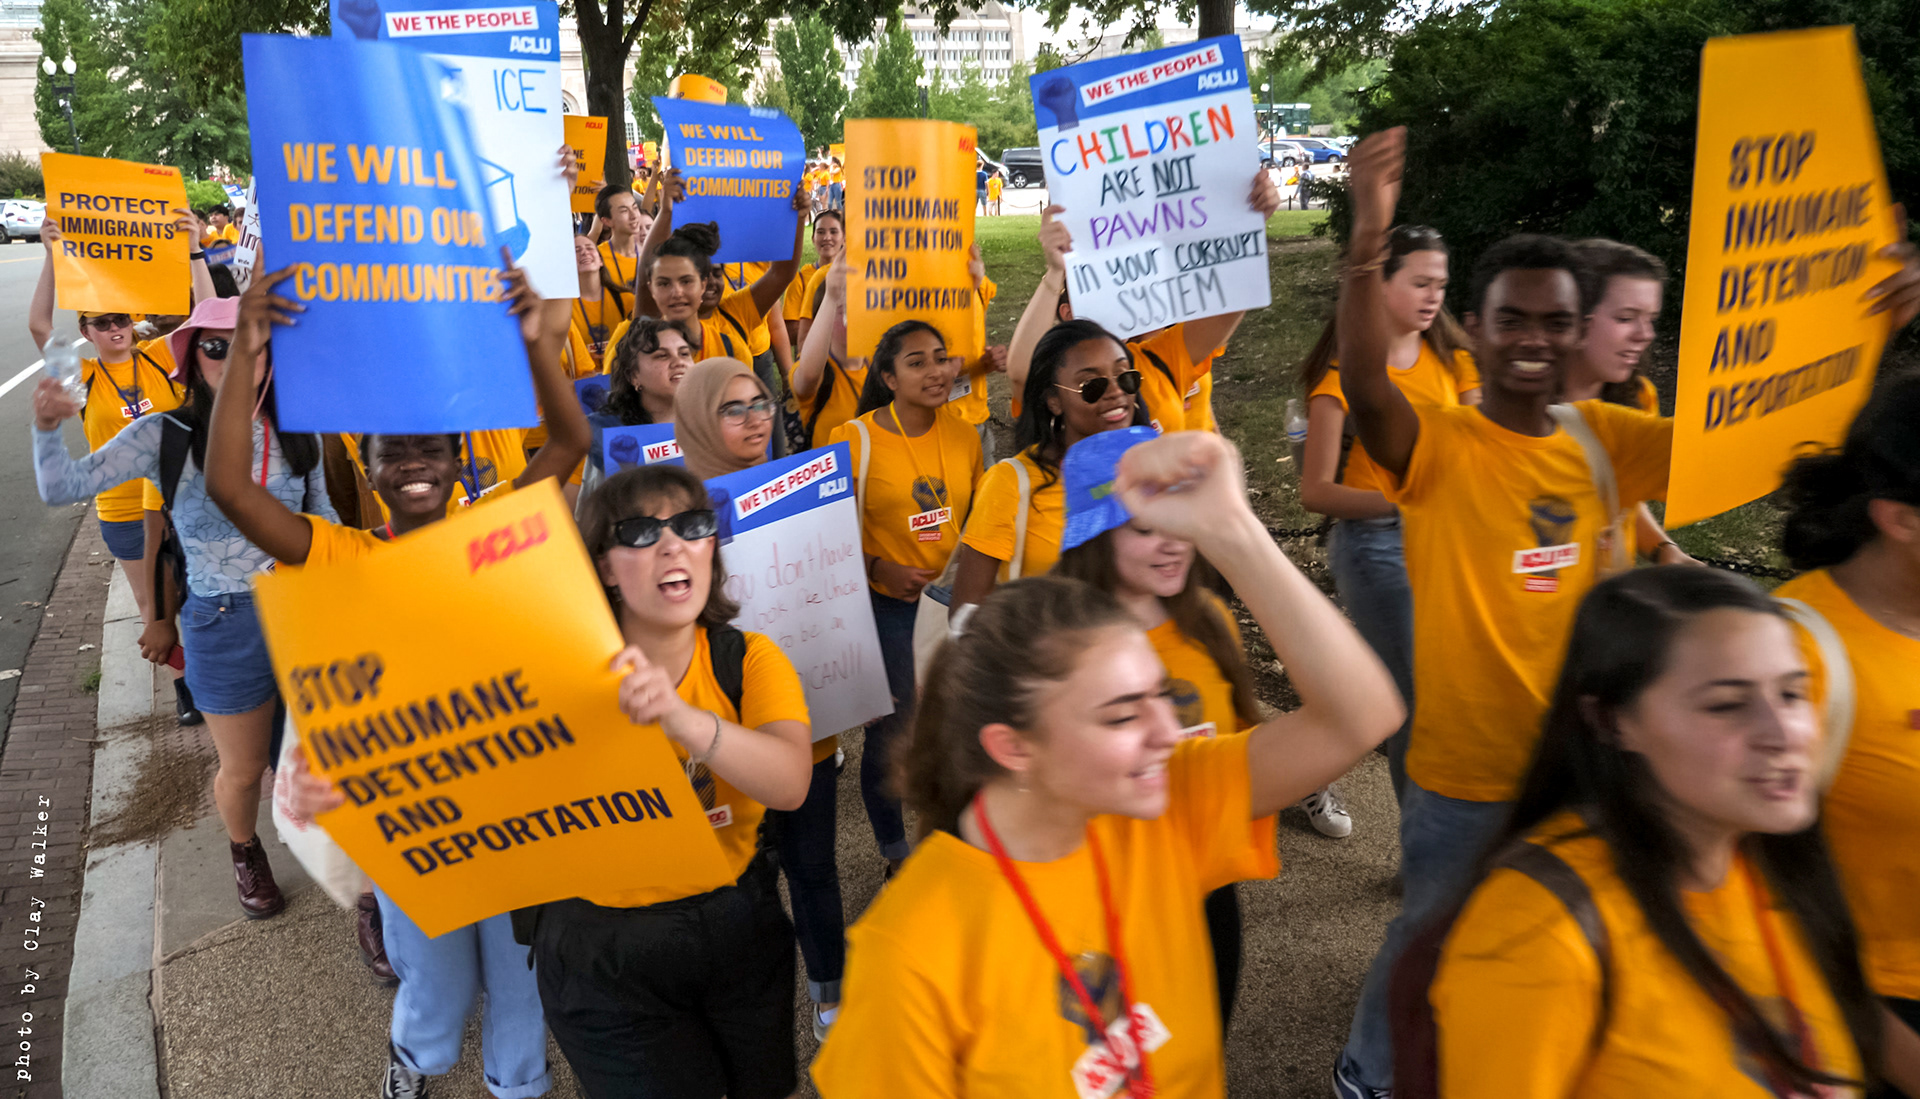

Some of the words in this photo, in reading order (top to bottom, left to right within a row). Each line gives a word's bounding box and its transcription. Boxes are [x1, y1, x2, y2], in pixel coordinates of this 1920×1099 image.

[392, 16, 422, 32] WE
[426, 14, 461, 30] THE
[465, 11, 533, 28] PEOPLE
[509, 35, 552, 55] ACLU
[493, 68, 547, 114] ICE
[1086, 81, 1115, 101] WE
[1116, 72, 1150, 93] THE
[1152, 49, 1218, 81] PEOPLE
[1198, 68, 1239, 91] ACLU
[679, 123, 706, 139] WE
[708, 125, 764, 141] WILL
[1051, 104, 1235, 176] CHILDREN
[283, 142, 339, 183] WE
[346, 143, 457, 189] WILL
[684, 147, 747, 168] DEFEND
[750, 149, 783, 169] OUR
[864, 165, 917, 191] STOP
[1727, 129, 1816, 191] STOP
[686, 176, 792, 198] COMMUNITIES
[1101, 166, 1145, 207] ARE
[1152, 154, 1200, 198] NOT
[60, 192, 169, 216] PROTECT
[289, 203, 424, 245] DEFEND
[431, 206, 486, 248] OUR
[864, 197, 960, 222] INHUMANE
[1090, 196, 1208, 250] PAWNS
[1721, 179, 1876, 255] INHUMANE
[61, 216, 175, 240] IMMIGRANTS
[865, 227, 962, 251] DETENTION
[62, 240, 153, 262] RIGHTS
[865, 257, 908, 281] AND
[1073, 261, 1101, 296] in
[1105, 247, 1162, 287] your
[1174, 229, 1264, 272] CORRUPT
[295, 261, 504, 304] COMMUNITIES
[866, 287, 971, 312] DEPORTATION
[1117, 267, 1227, 332] SYSTEM
[1708, 317, 1777, 376] AND
[647, 445, 670, 460] WE
[738, 493, 762, 514] WE
[761, 480, 786, 502] THE
[787, 457, 834, 488] PEOPLE
[818, 476, 849, 499] ACLU
[912, 512, 937, 528] ACLU
[466, 511, 551, 575] ACLU
[727, 573, 754, 602] ou
[289, 651, 385, 715] STOP
[308, 668, 539, 772] INHUMANE
[337, 713, 576, 809] DETENTION
[374, 795, 463, 844] AND
[401, 787, 673, 877] DEPORTATION
